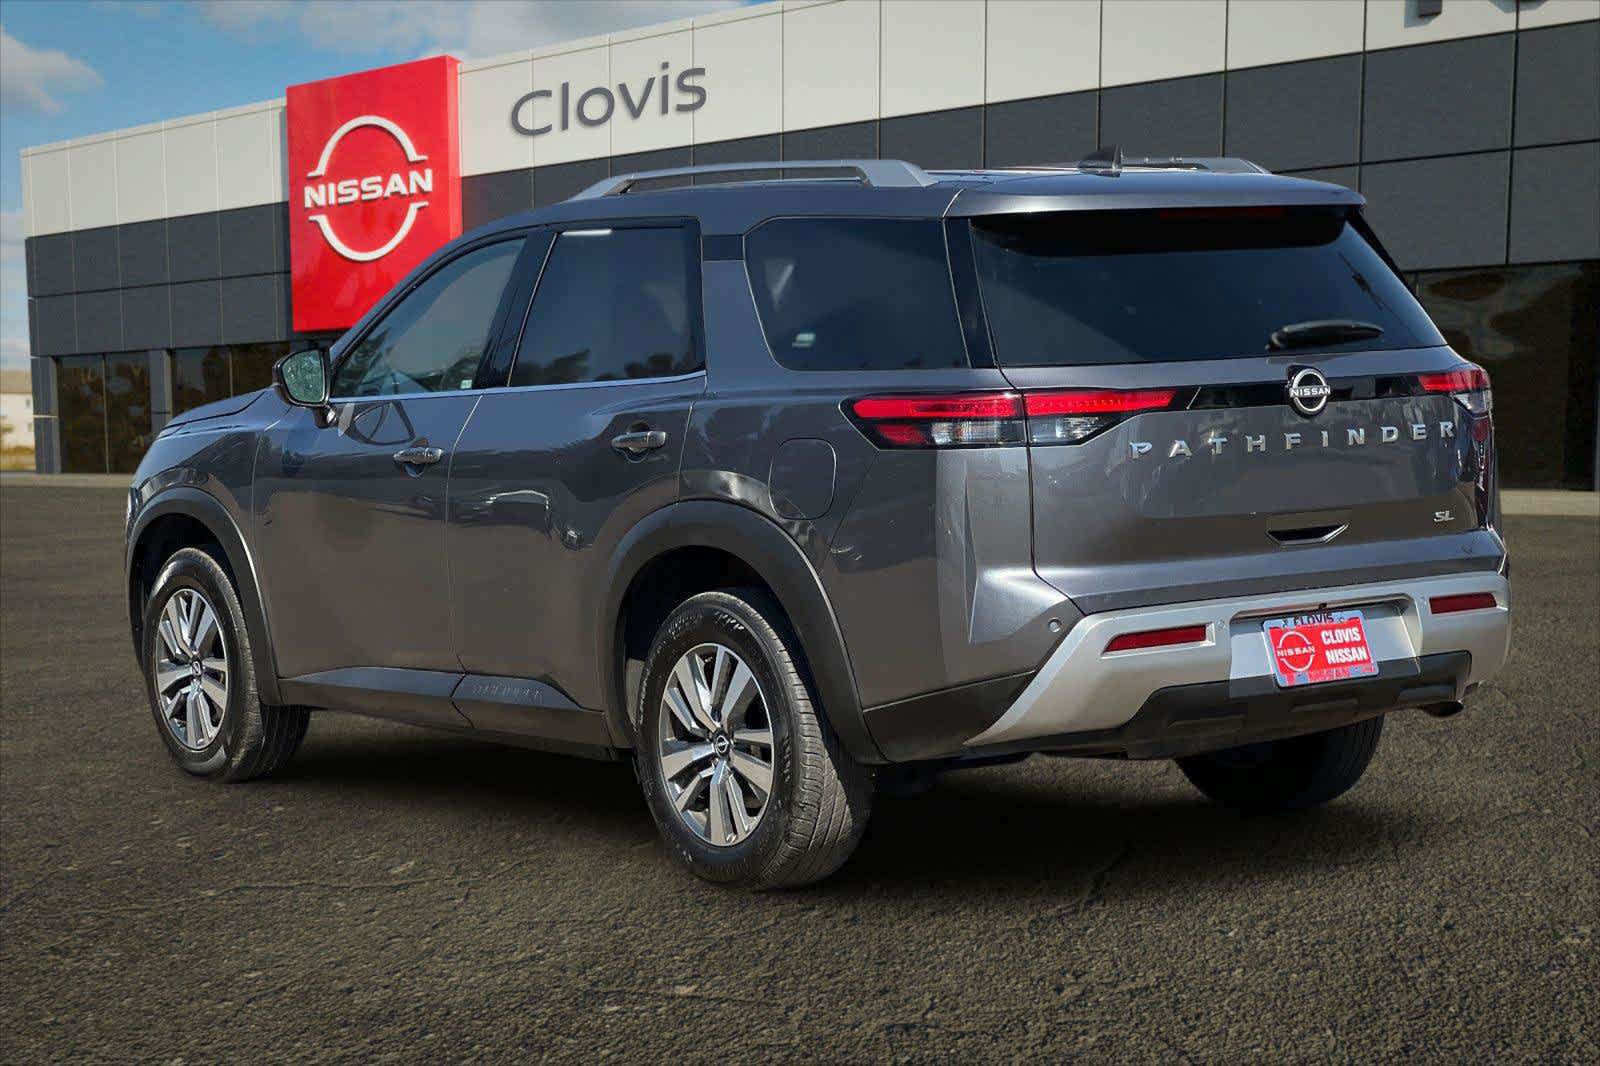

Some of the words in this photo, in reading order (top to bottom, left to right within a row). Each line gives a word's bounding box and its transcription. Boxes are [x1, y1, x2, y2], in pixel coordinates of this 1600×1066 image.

[510, 62, 708, 137] Clovis
[304, 168, 434, 208] NISSAN
[1289, 386, 1331, 398] NISSAN
[1129, 420, 1456, 459] PATHFINDER
[1433, 510, 1455, 522] SL
[1320, 627, 1361, 645] CLOVIS
[1277, 646, 1315, 657] NISSAN
[1325, 646, 1368, 663] NISSAN
